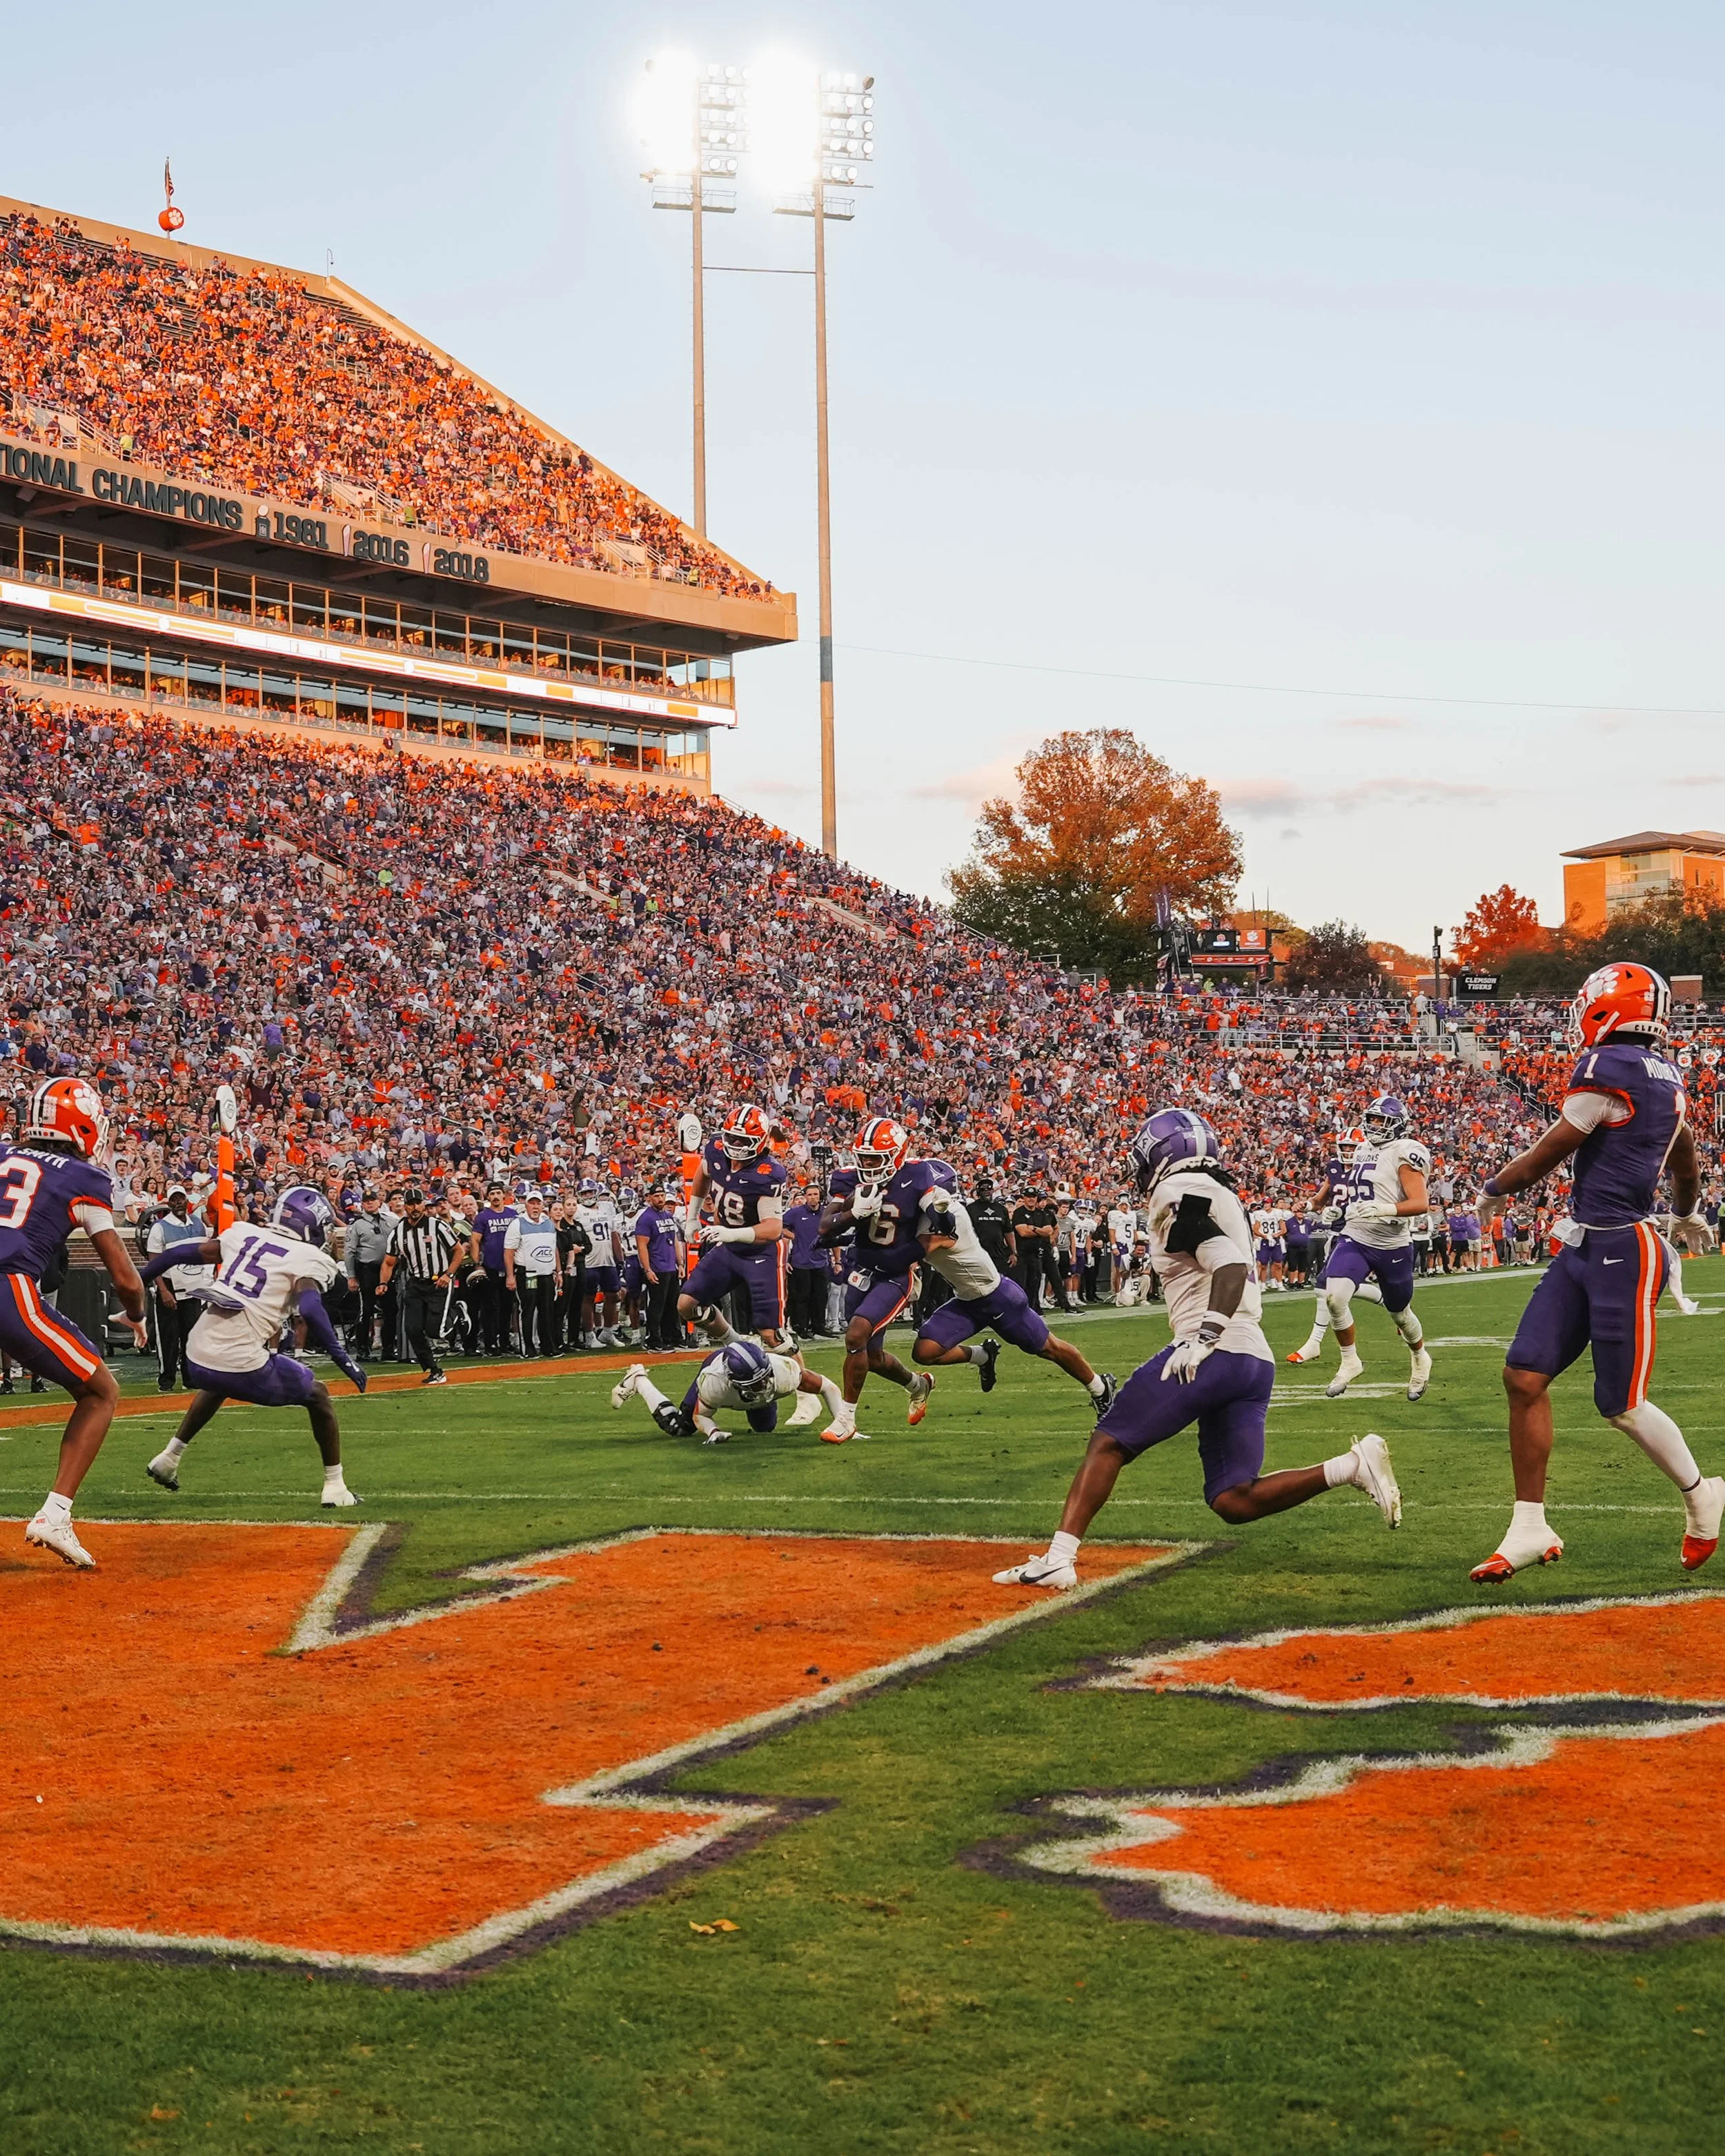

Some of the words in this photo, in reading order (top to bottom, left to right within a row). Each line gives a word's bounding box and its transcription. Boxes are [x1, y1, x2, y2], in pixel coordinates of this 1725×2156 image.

[92, 468, 243, 531] CHAMPIONS
[274, 511, 328, 550] 1981
[353, 531, 409, 566] 2016
[434, 548, 489, 583] 2018
[1584, 1053, 1599, 1078] 1
[17, 1148, 70, 1169] SMITH
[0, 1156, 43, 1229] 3
[711, 1179, 745, 1226] 78
[593, 1222, 610, 1241] 91
[868, 1203, 900, 1246] 6
[1125, 1223, 1132, 1238] 5
[1262, 1220, 1276, 1234] 84
[218, 1236, 289, 1298] 15
